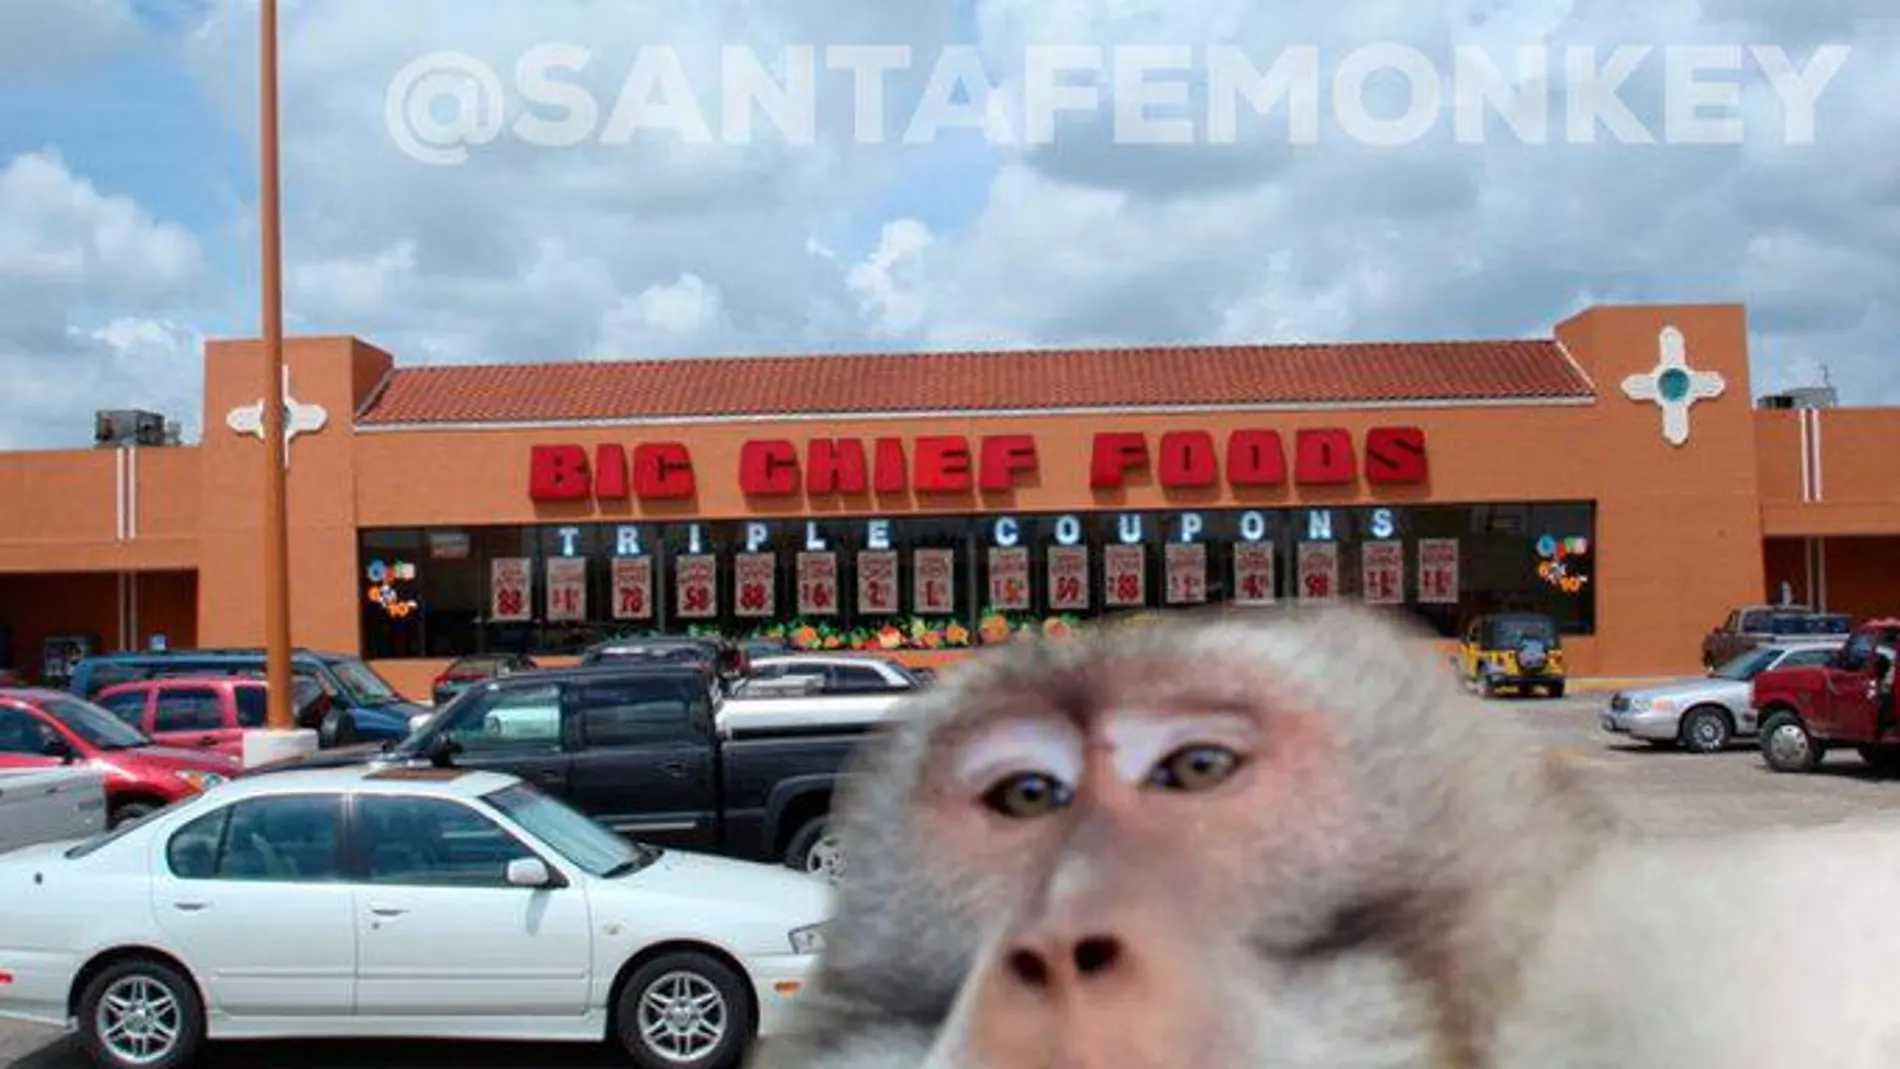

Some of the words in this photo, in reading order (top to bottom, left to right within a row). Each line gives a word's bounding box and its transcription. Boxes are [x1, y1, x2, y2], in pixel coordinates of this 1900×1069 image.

[529, 442, 694, 499] BIG
[739, 434, 1039, 496] CHIEF
[1090, 427, 1428, 488] FOODS
[558, 520, 890, 556] TRIPLE
[995, 508, 1394, 546] COUPONS
